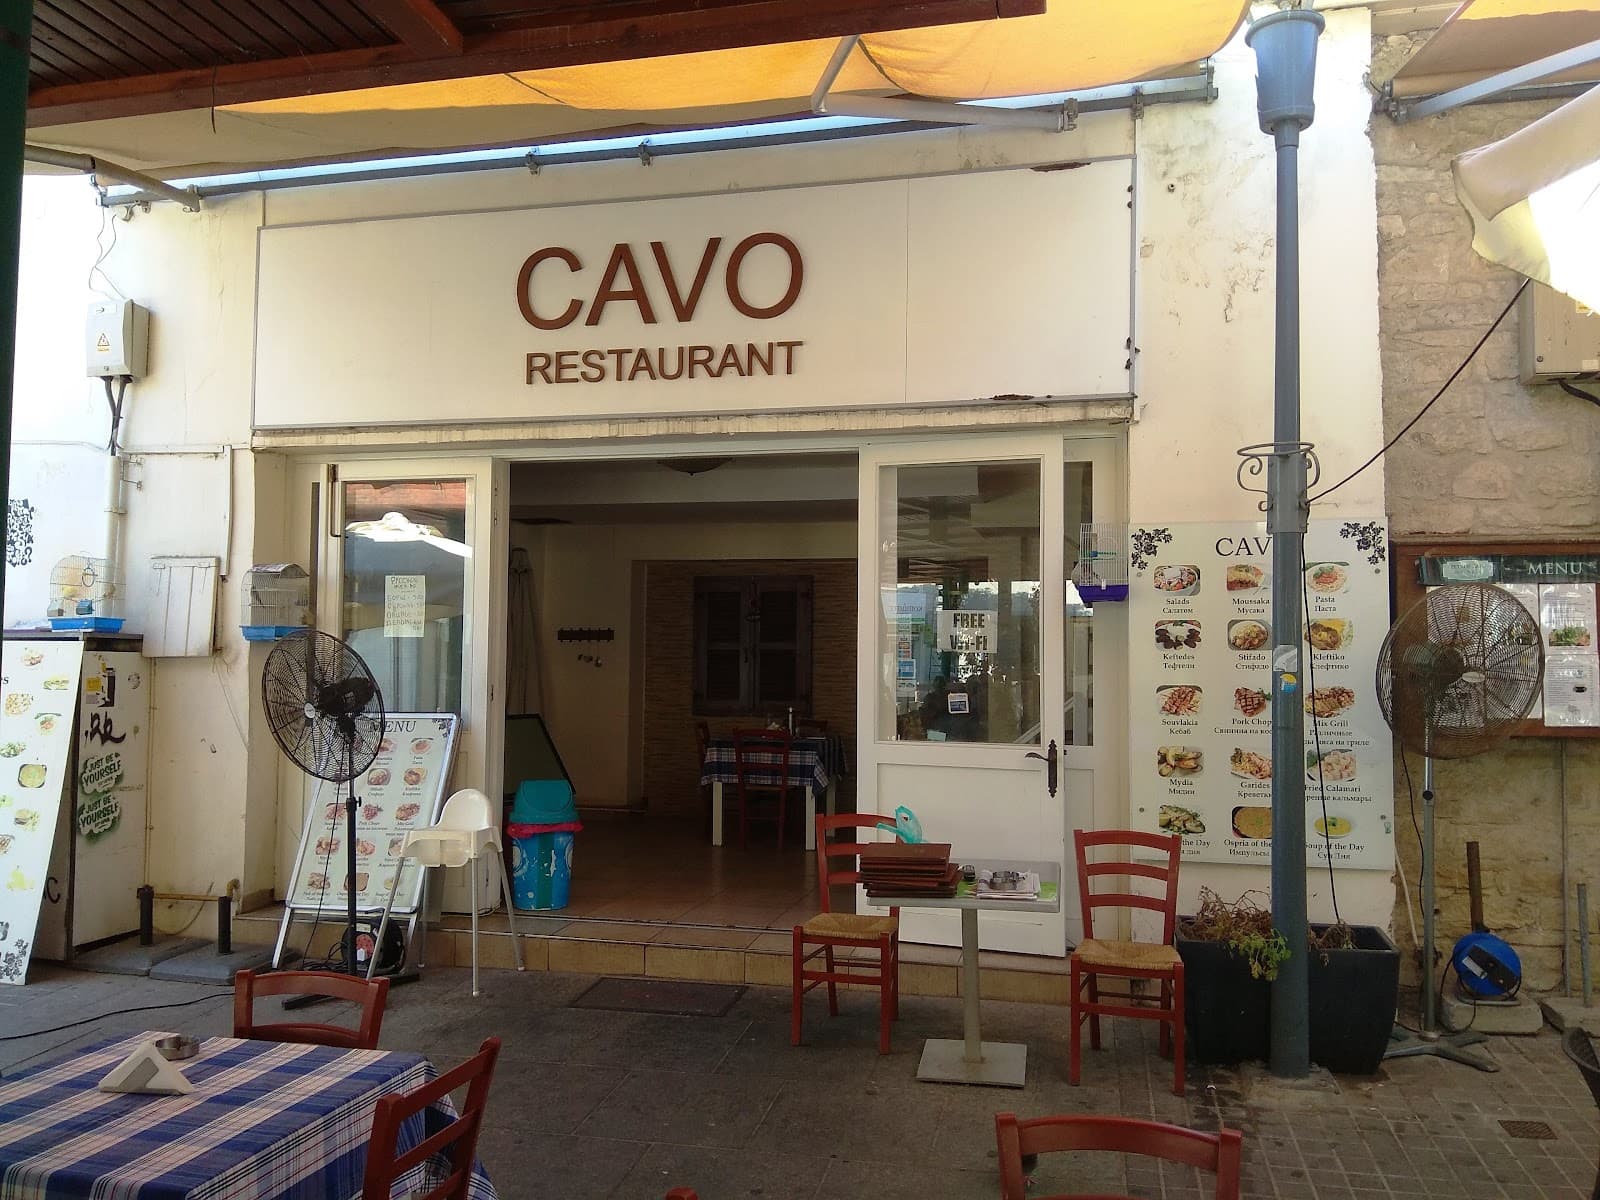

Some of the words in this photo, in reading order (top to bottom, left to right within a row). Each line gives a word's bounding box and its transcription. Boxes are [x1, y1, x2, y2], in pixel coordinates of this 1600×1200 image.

[516, 232, 804, 331] CAVO
[526, 340, 804, 385] RESTAURANT
[1215, 536, 1273, 557] CAV
[1528, 561, 1582, 575] MENU
[1232, 597, 1270, 605] Moussaka
[1237, 607, 1264, 615] Мусака
[953, 612, 985, 628] FREE
[1330, 719, 1349, 727] Grill
[87, 757, 104, 773] JUST
[105, 753, 114, 765] BE
[83, 759, 121, 787] YOURSELF
[1170, 779, 1193, 787] Mydia
[1240, 781, 1270, 789] Garides
[1326, 784, 1361, 792] Calamari
[85, 798, 102, 815] JUST
[103, 794, 112, 806] BE
[80, 801, 119, 829] YOURSELF
[1196, 839, 1211, 848] Day
[1224, 839, 1249, 848] Ospria
[1251, 839, 1259, 847] of
[1334, 842, 1347, 850] the
[1349, 843, 1365, 853] Day
